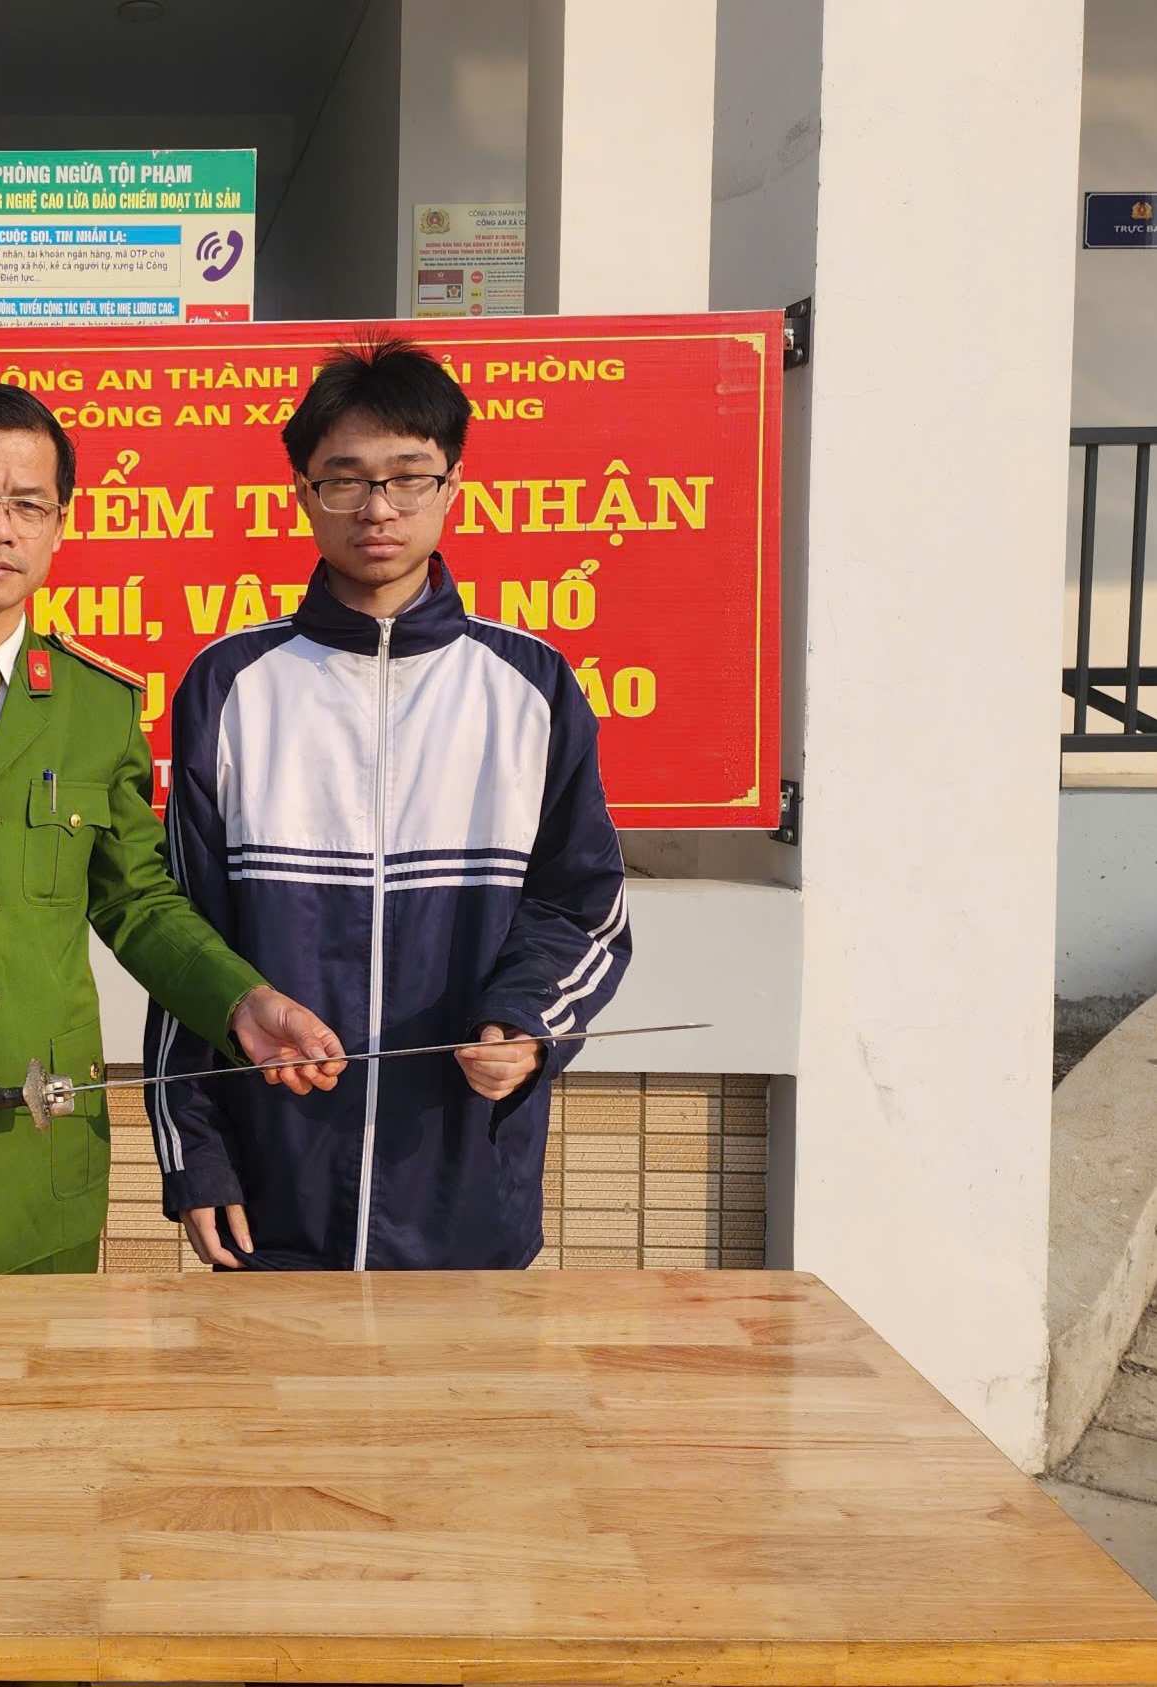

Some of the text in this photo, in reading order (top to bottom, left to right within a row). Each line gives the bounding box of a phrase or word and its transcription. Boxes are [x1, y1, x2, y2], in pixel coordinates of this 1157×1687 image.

[55, 161, 104, 184] NGỪA
[109, 161, 136, 188] TỘI
[141, 165, 192, 188] PHẠM
[6, 189, 37, 213] NGHỆ
[40, 193, 64, 209] CAO
[67, 189, 89, 209] LỪA
[92, 188, 117, 209] ĐẢO
[119, 188, 157, 209] CHIẾM
[160, 192, 191, 213] ĐOẠT
[194, 189, 212, 209] TÀI
[216, 187, 241, 209] SẢN
[31, 230, 52, 245] GỌI,
[55, 230, 73, 243] TIN
[76, 227, 107, 243] NHẮN
[110, 230, 127, 245] LẠ:
[1114, 224, 1144, 234] TRỰC
[67, 250, 88, 260] ngân
[130, 250, 148, 258] OTP
[150, 249, 166, 258] cho
[73, 261, 99, 272] người
[101, 262, 111, 272] tự
[112, 262, 134, 272] xưng
[146, 261, 168, 272] Công
[0, 272, 19, 284] Điện
[64, 300, 79, 314] TÁC
[158, 302, 175, 314] CAO:
[97, 369, 152, 390] AN
[164, 362, 298, 389] THÀNH
[442, 354, 471, 384] ẢI
[486, 356, 626, 383] PHÒNG
[52, 398, 544, 428] CÔNG AN XÃ ANG
[61, 450, 214, 540] IỂM
[455, 459, 714, 546] NHẬN
[33, 575, 163, 641] KHÍ,
[500, 559, 600, 630] NỔ
[575, 657, 657, 718] ÁO
